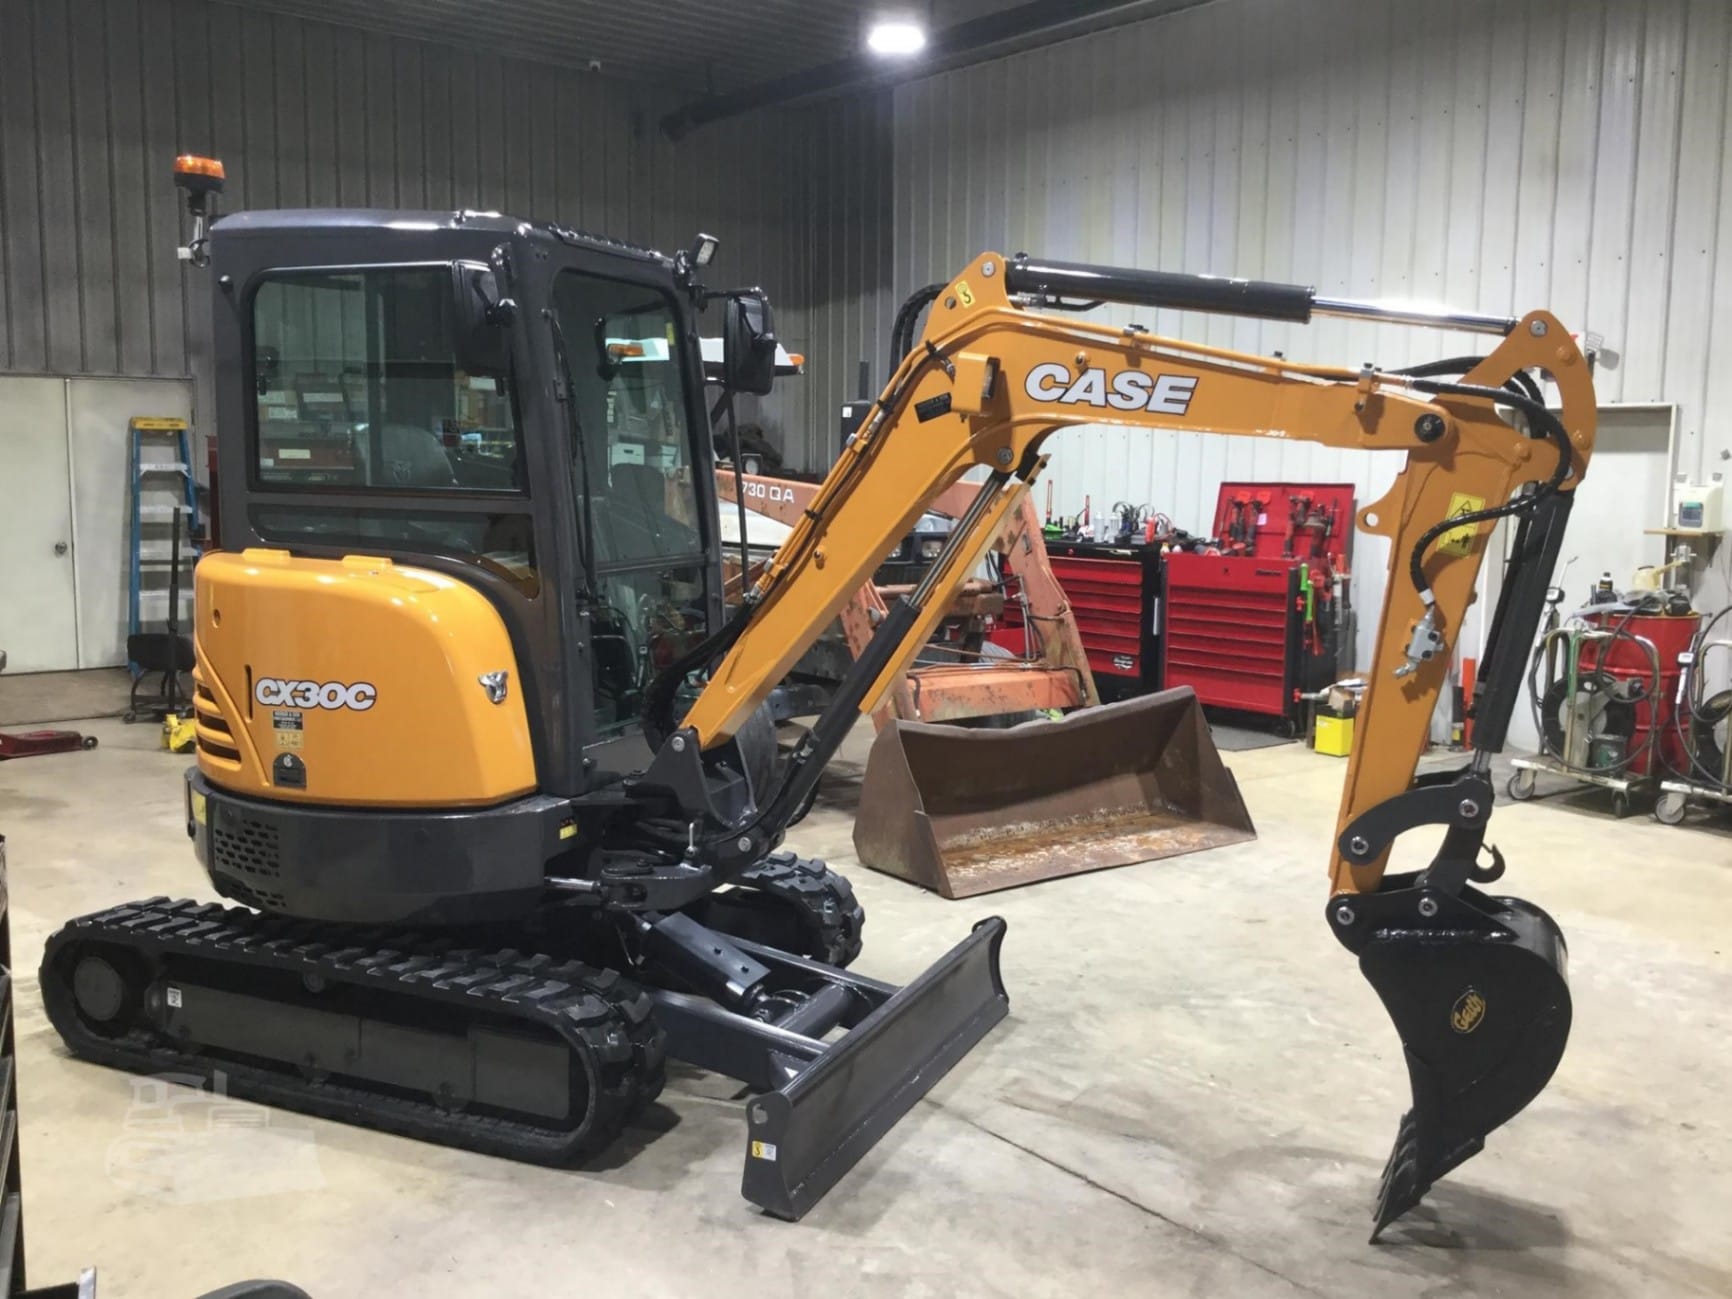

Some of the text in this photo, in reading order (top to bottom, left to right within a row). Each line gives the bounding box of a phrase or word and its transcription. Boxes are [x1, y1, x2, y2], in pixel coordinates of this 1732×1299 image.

[1025, 363, 1198, 414] CASE
[769, 486, 795, 504] QA
[256, 677, 377, 711] CX30C
